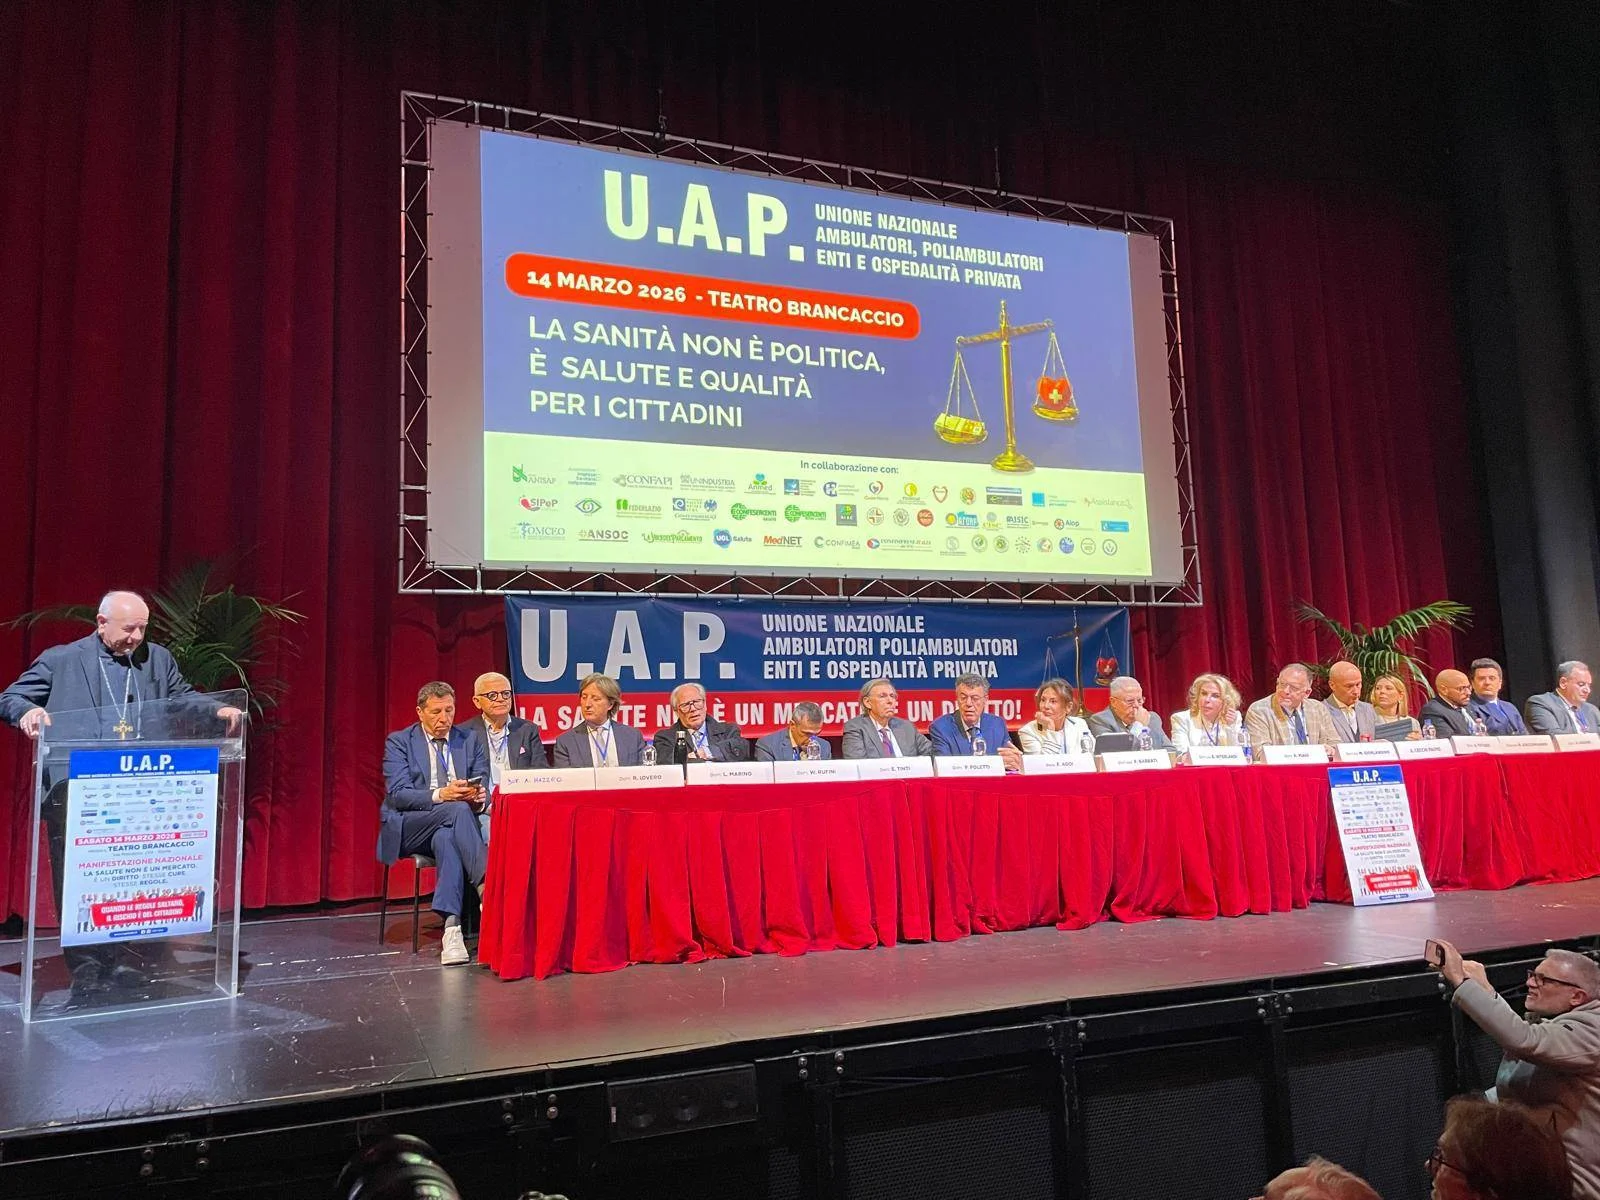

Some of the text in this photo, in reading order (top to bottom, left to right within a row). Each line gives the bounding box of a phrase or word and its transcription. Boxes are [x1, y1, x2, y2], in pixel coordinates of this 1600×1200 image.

[604, 170, 805, 262] U.A.P.
[815, 203, 958, 239] UNIONE NAZIONALE
[816, 227, 1044, 272] AMBULATORI, POLIAMBULATORI
[817, 250, 1022, 290] ENTI E OSPEDALITÀ PRIVATA
[527, 272, 552, 289] 14
[557, 272, 633, 296] MARZO
[638, 284, 686, 303] 2026
[708, 290, 783, 313] TEATRO
[788, 301, 904, 327] BRANCACCIO
[529, 316, 886, 376] LA SANITÀ NON È POLITICA,
[529, 350, 812, 399] È SALUTE E QUALITÀ
[530, 391, 743, 427] PER I CITTADINI
[801, 460, 899, 474] In collaborazione con:
[626, 474, 673, 486] CONFAPI
[588, 529, 629, 540] ANSOC
[762, 615, 925, 633] UNIONE NAZIONALE
[521, 609, 736, 682] U.A.P.
[764, 638, 1018, 656] AMBULATORI POLIAMBULATORI
[764, 658, 998, 679] ENTI E OSPEDALITÀ PRIVATA
[713, 698, 726, 723] È
[735, 703, 764, 725] UN
[907, 701, 934, 722] UN
[120, 754, 175, 772] U.A.P.
[1352, 770, 1382, 783] U.A.P.
[108, 844, 140, 852] TEATRO
[143, 841, 195, 850] BRANCACCIO
[124, 834, 153, 842] MARZO
[154, 833, 176, 841] 2026
[79, 854, 203, 869] MANIFESTAZIONE NAZIONALE
[101, 905, 126, 914] QUANDO
[135, 902, 156, 910] REGOLE
